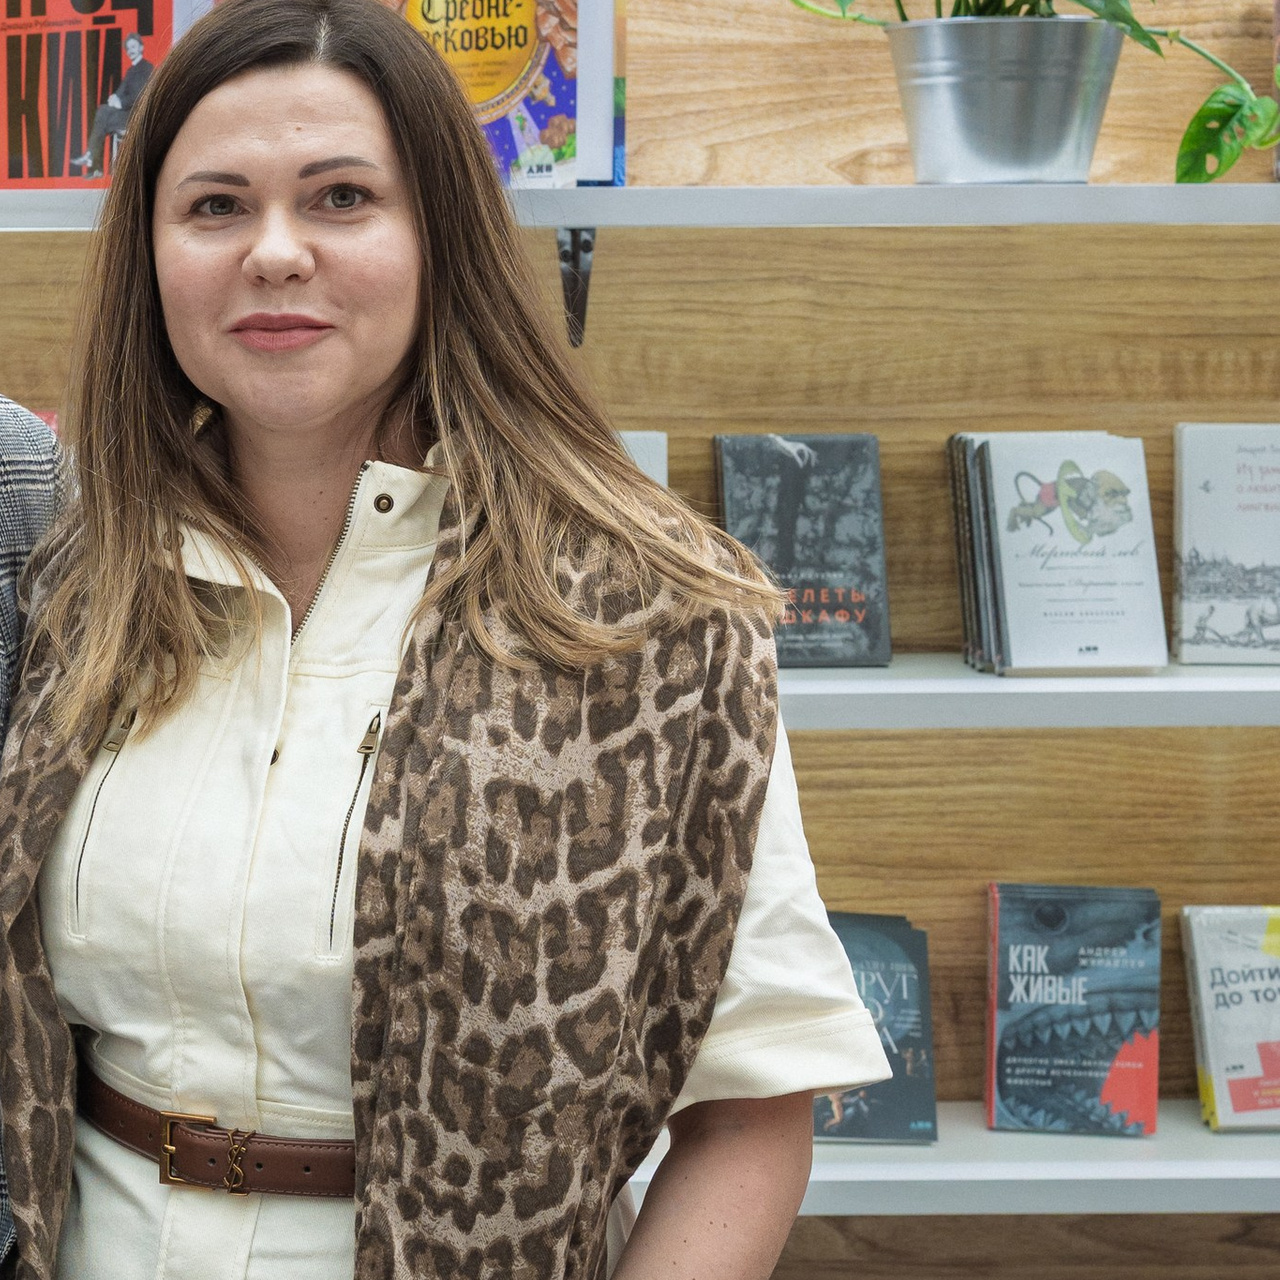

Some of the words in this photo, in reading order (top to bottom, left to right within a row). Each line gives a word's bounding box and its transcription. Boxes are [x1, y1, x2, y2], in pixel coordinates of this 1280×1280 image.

[1008, 944, 1050, 973] КАК
[1008, 974, 1089, 1005] ЖИВЫЕ
[1214, 991, 1243, 1009] до
